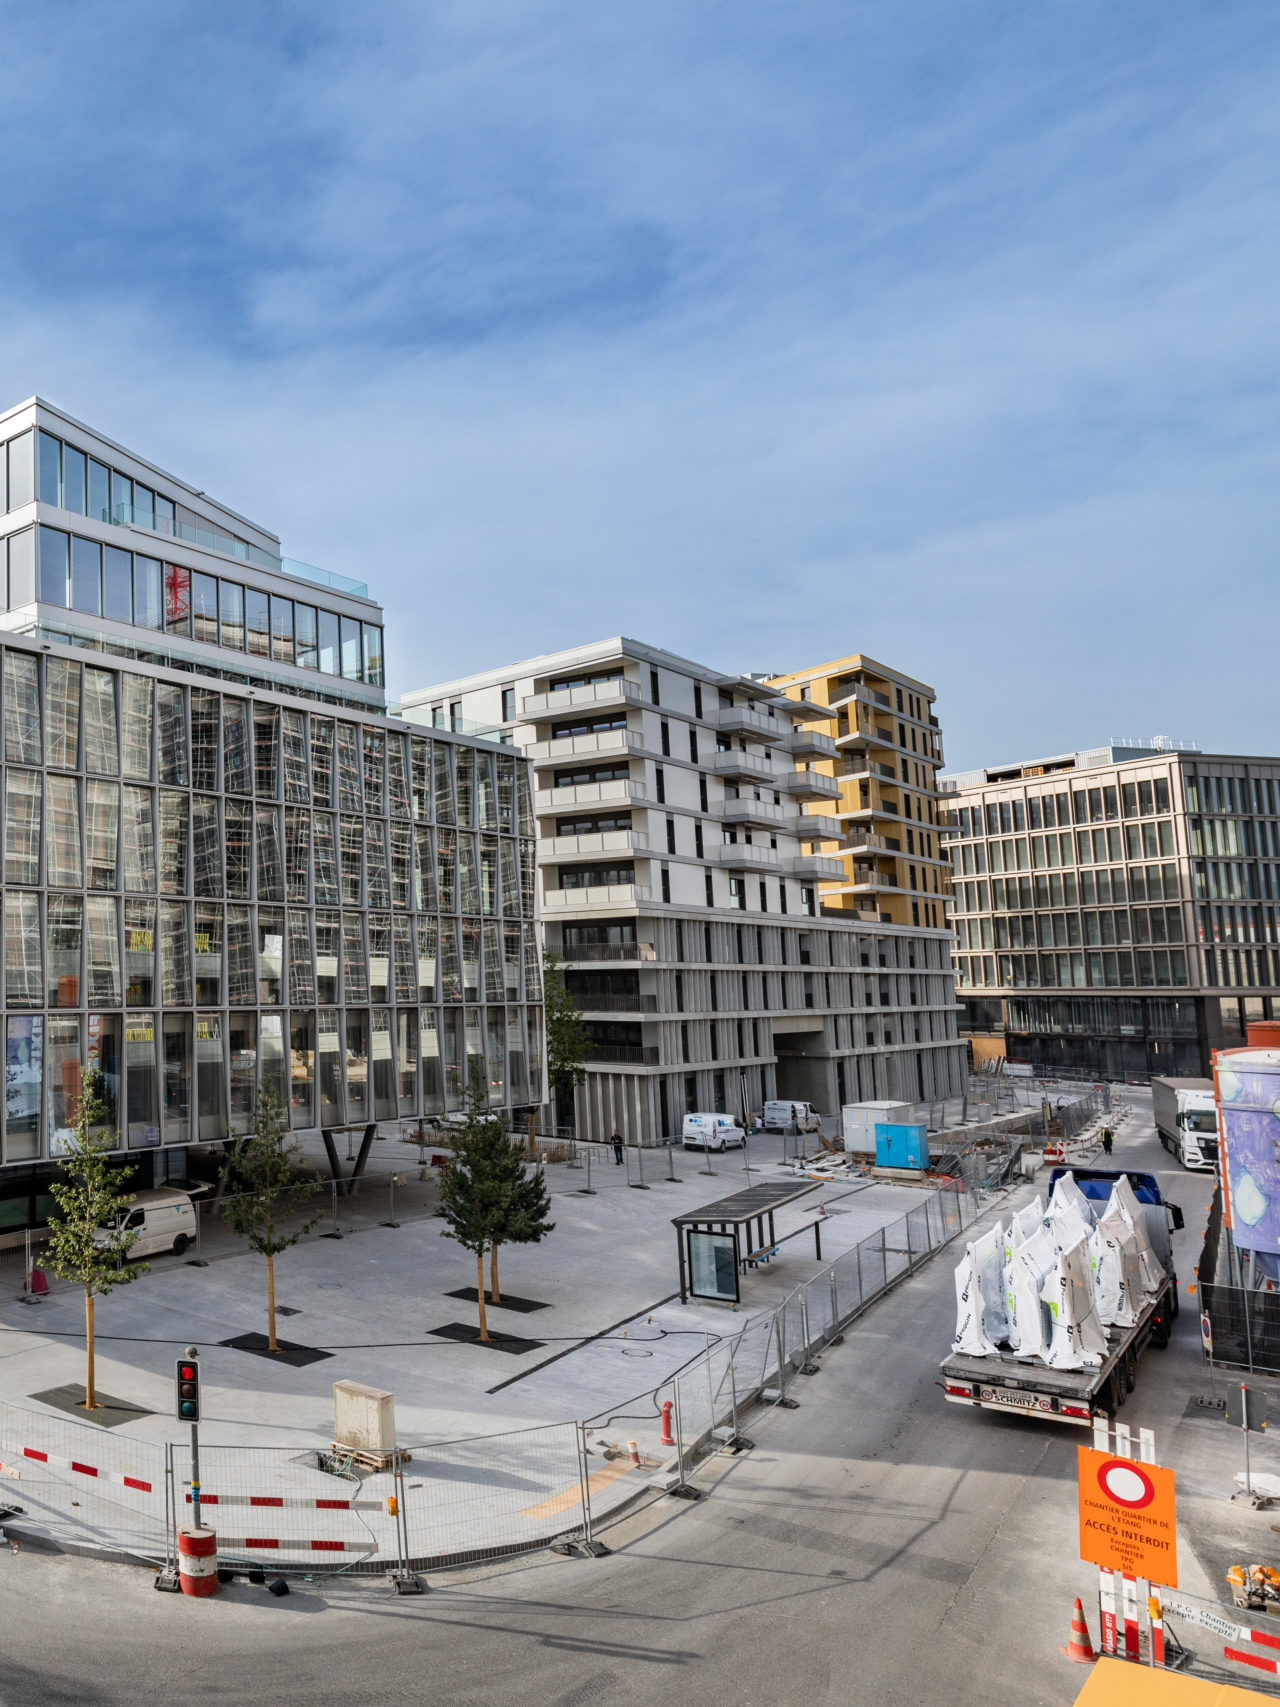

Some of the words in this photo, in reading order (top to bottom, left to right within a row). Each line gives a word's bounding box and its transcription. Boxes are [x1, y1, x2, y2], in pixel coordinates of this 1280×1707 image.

[994, 1395, 1037, 1408] SCHMITZ
[1084, 1499, 1120, 1514] CHANTIER
[1122, 1511, 1158, 1525] QUARTIER
[1160, 1521, 1169, 1529] DE
[1085, 1519, 1118, 1535] ACCÈS
[1122, 1529, 1170, 1550] INTERDIT
[1110, 1545, 1144, 1559] CHANTIER
[1121, 1555, 1134, 1564] TPG
[1122, 1563, 1133, 1572] SIS
[1200, 1610, 1237, 1632] Chantier
